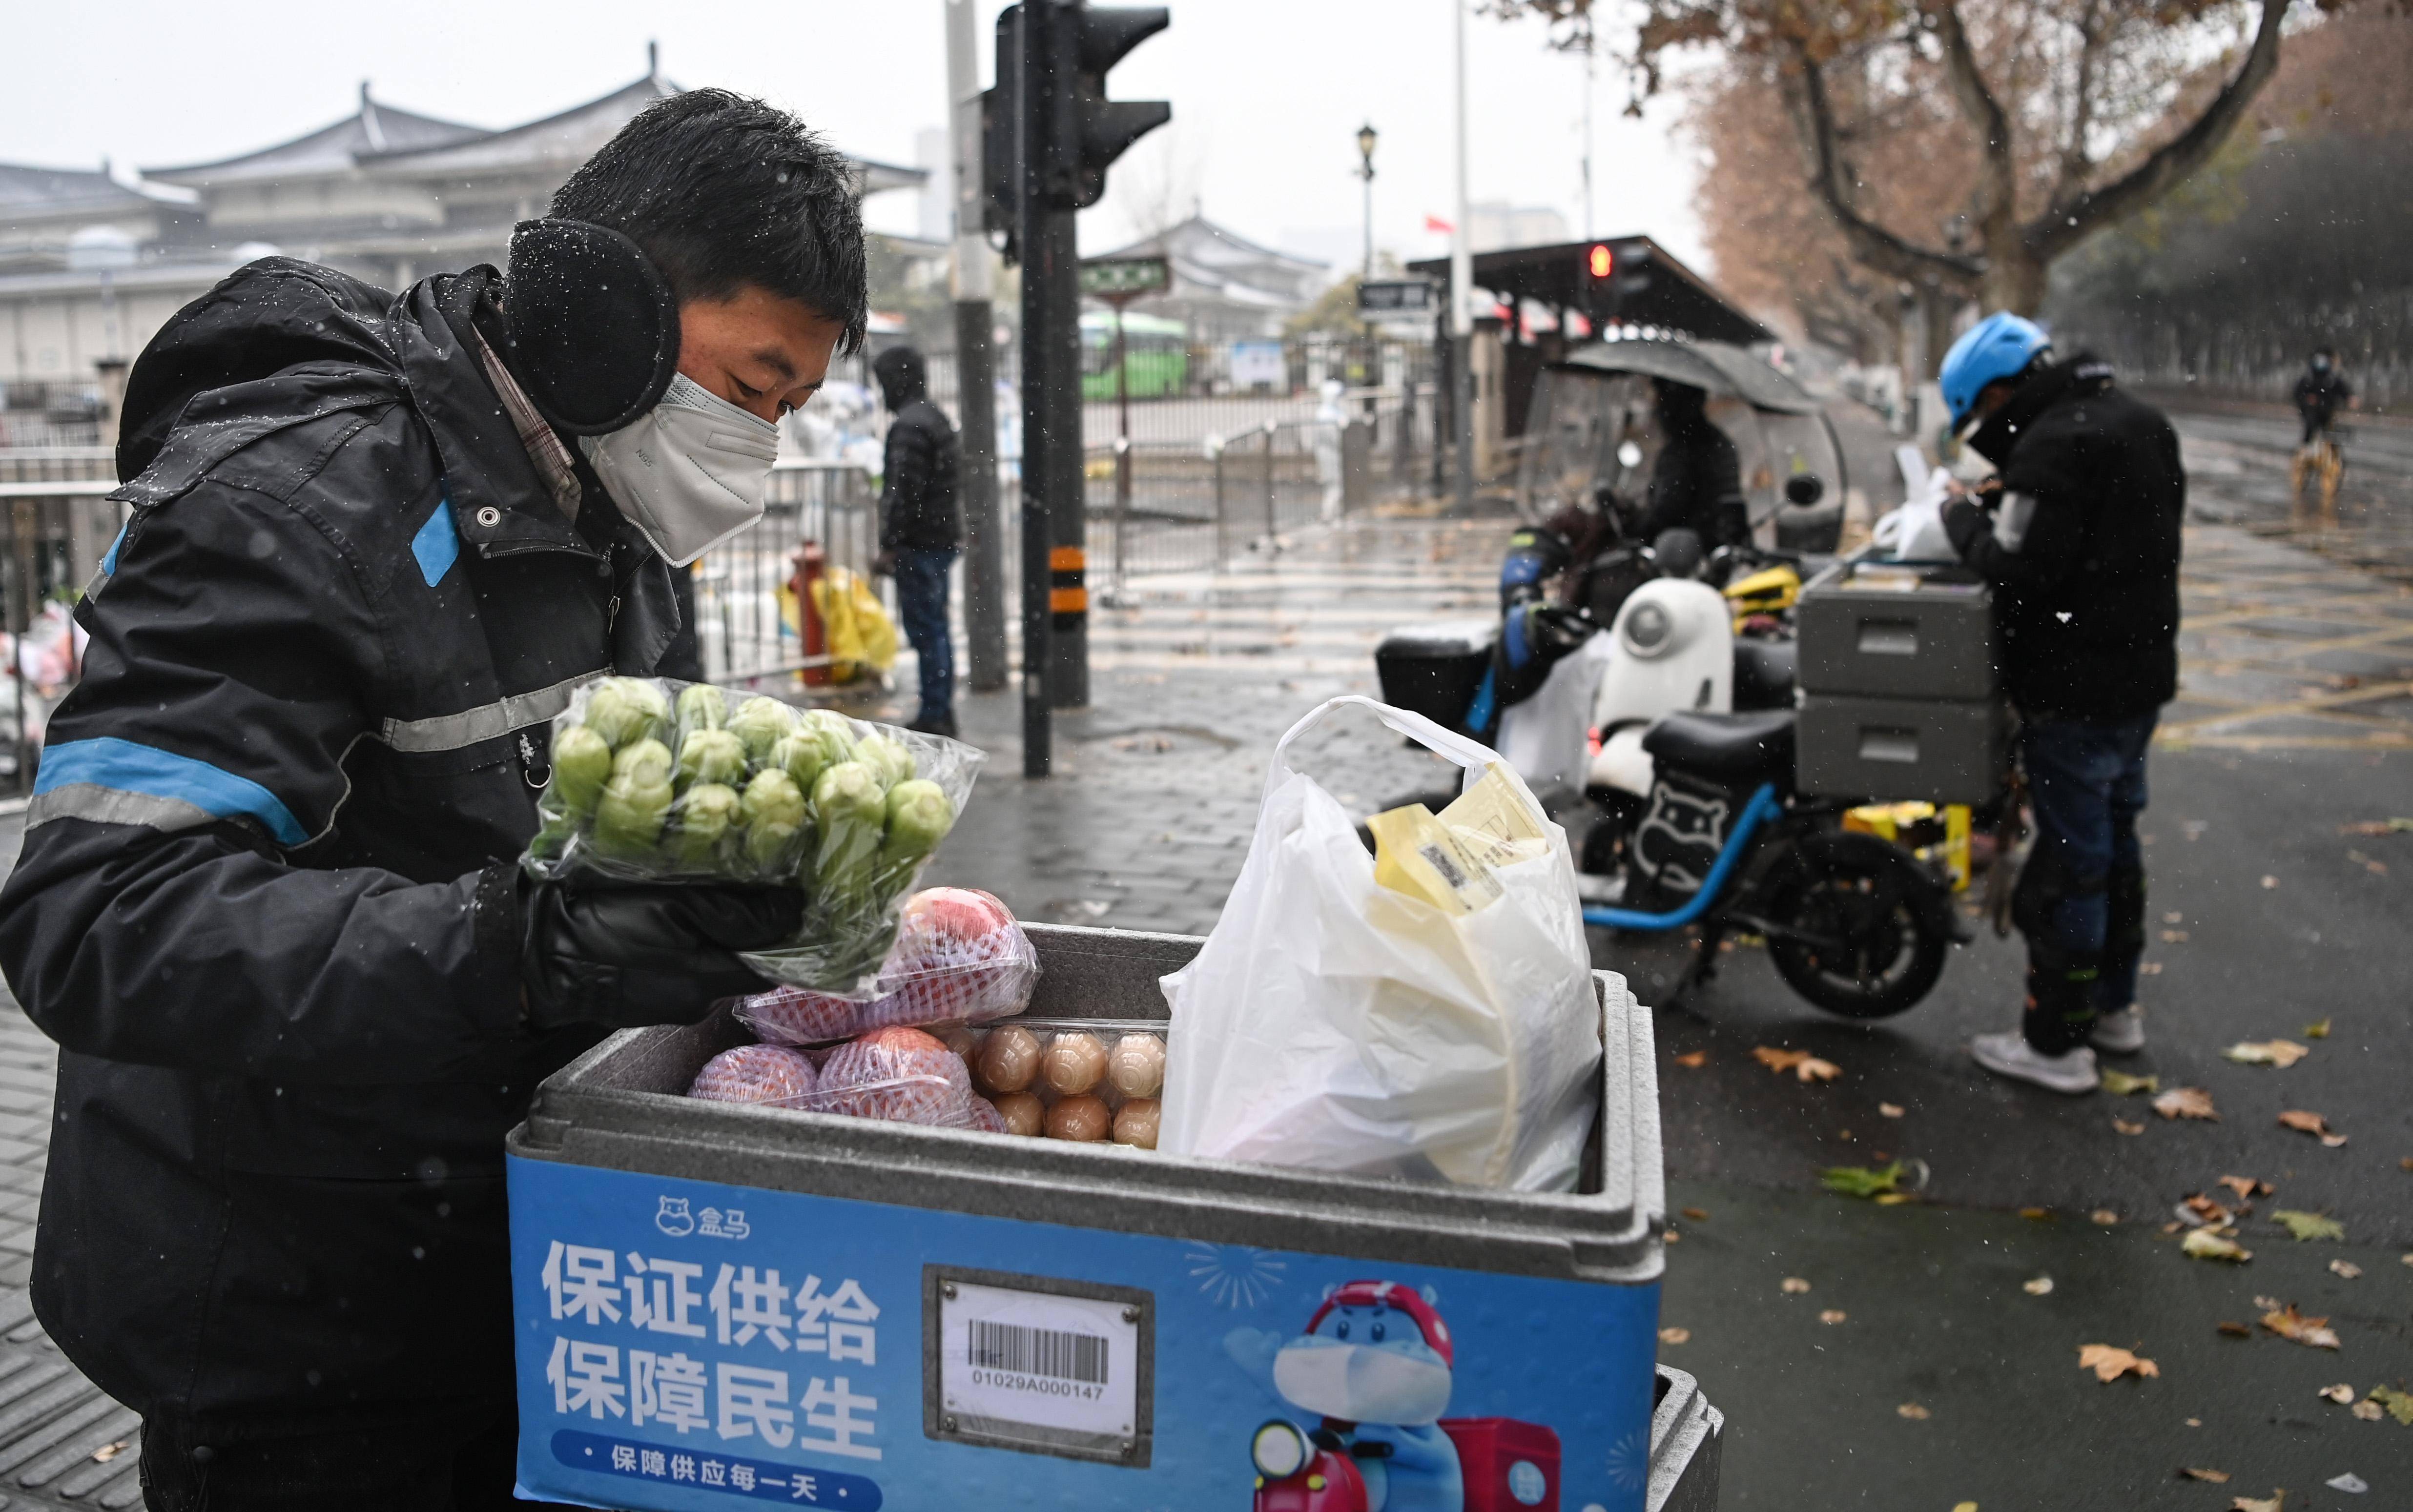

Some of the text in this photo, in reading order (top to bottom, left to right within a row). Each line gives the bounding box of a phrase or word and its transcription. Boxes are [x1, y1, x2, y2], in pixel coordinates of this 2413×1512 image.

[635, 449, 652, 467] N95
[698, 1206, 750, 1240] 盒马
[541, 1240, 880, 1366] 保证供给
[546, 1335, 882, 1461] 保障民生
[973, 1369, 1103, 1401] 01029A000147
[611, 1444, 818, 1502] 保障供应每一天
